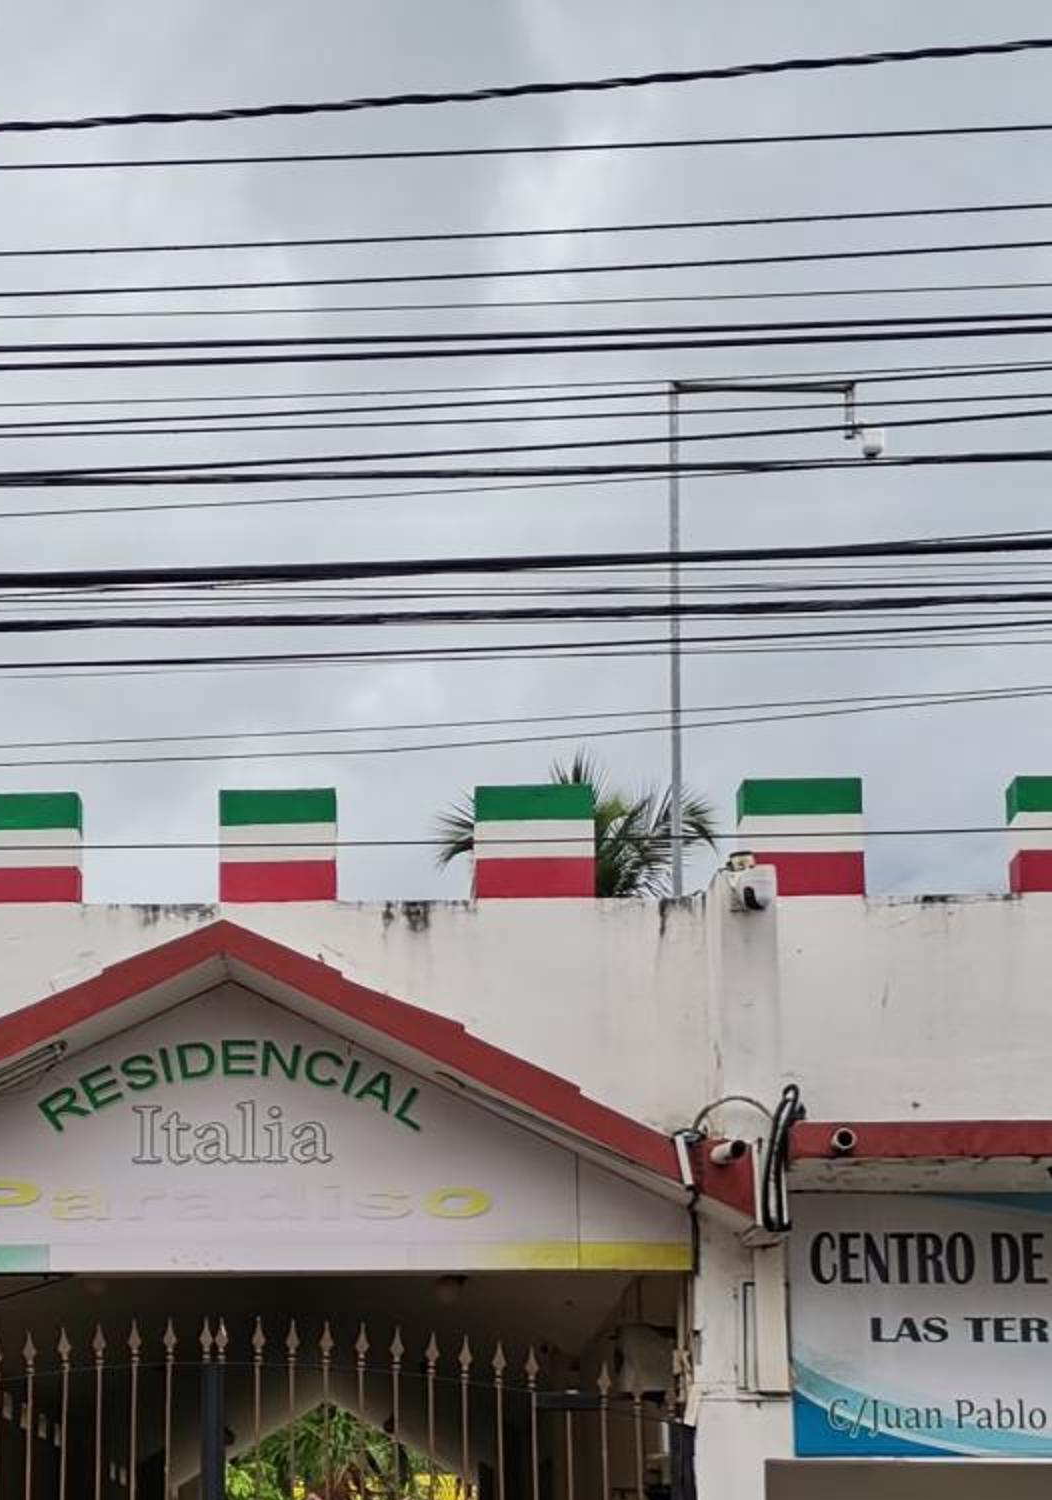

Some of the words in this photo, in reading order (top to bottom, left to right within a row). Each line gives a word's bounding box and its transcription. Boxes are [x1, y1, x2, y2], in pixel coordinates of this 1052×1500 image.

[36, 1038, 423, 1133] RESIDENCIAL
[131, 1100, 334, 1165] Italia
[811, 1232, 974, 1284] CENTRO
[991, 1232, 1048, 1284] DE
[870, 1317, 948, 1342] LAS
[964, 1317, 1050, 1342] TER
[826, 1399, 943, 1439] C/Juan
[954, 1398, 1048, 1430] Pablo
